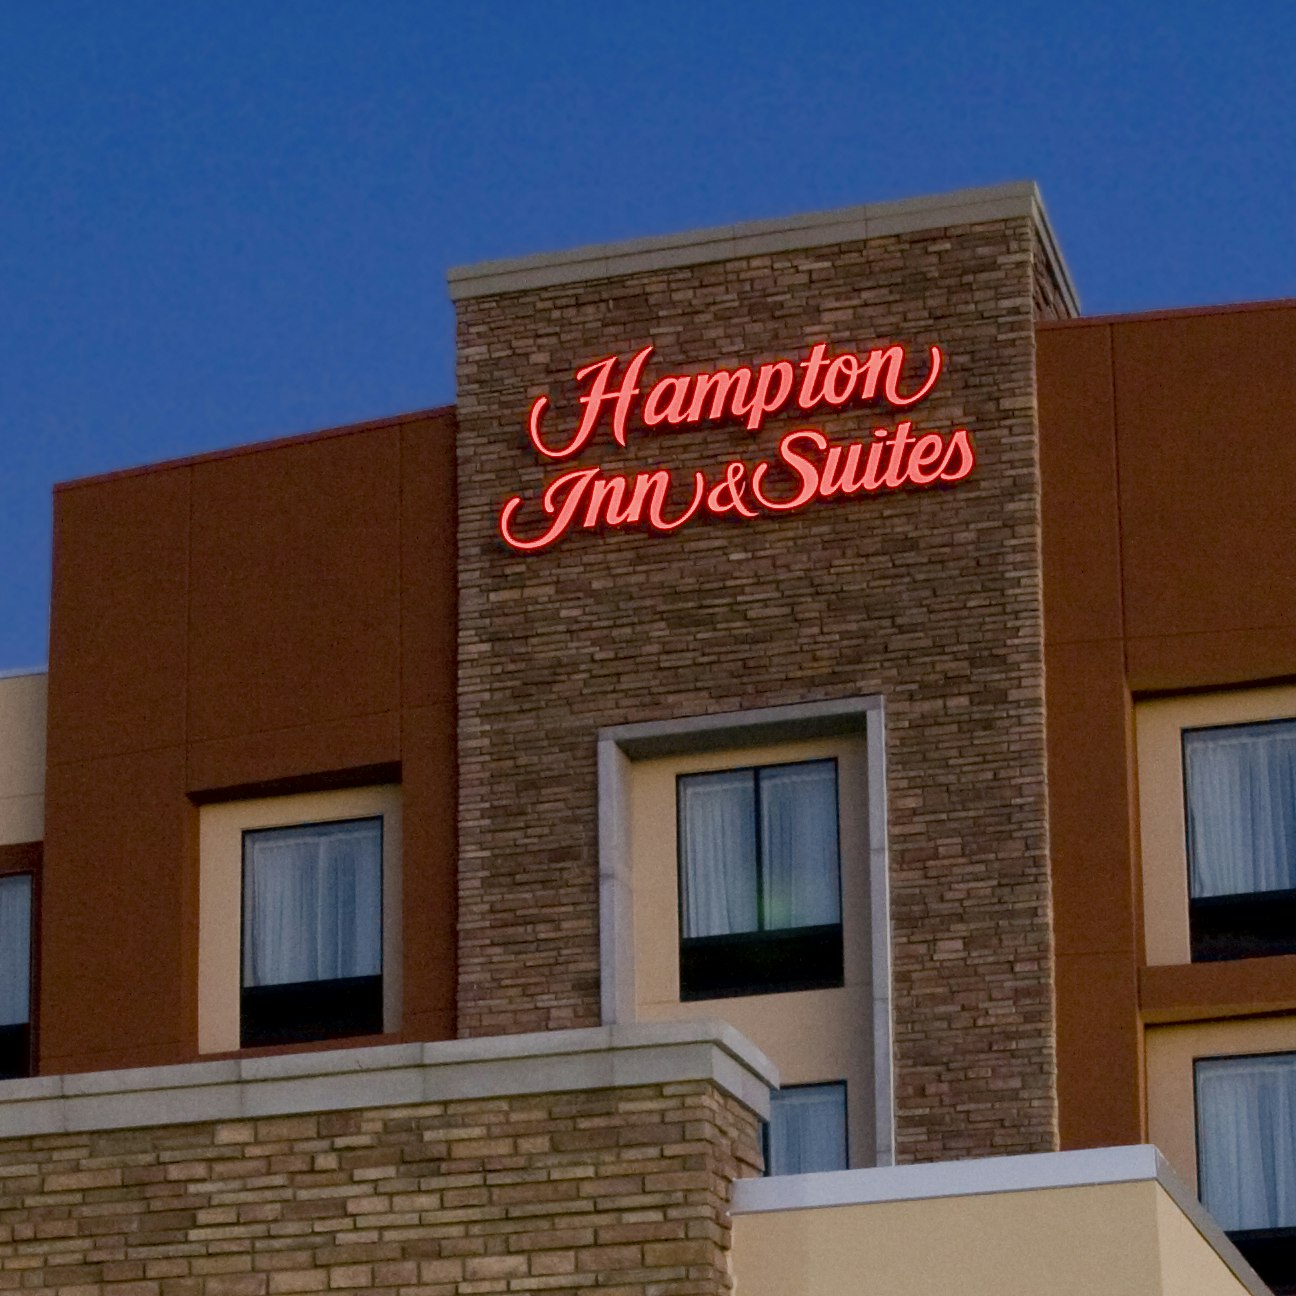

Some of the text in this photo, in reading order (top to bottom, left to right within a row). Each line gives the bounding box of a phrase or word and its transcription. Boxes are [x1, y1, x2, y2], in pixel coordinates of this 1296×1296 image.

[529, 342, 943, 459] Hampton
[501, 421, 975, 550] Inn & Suites
